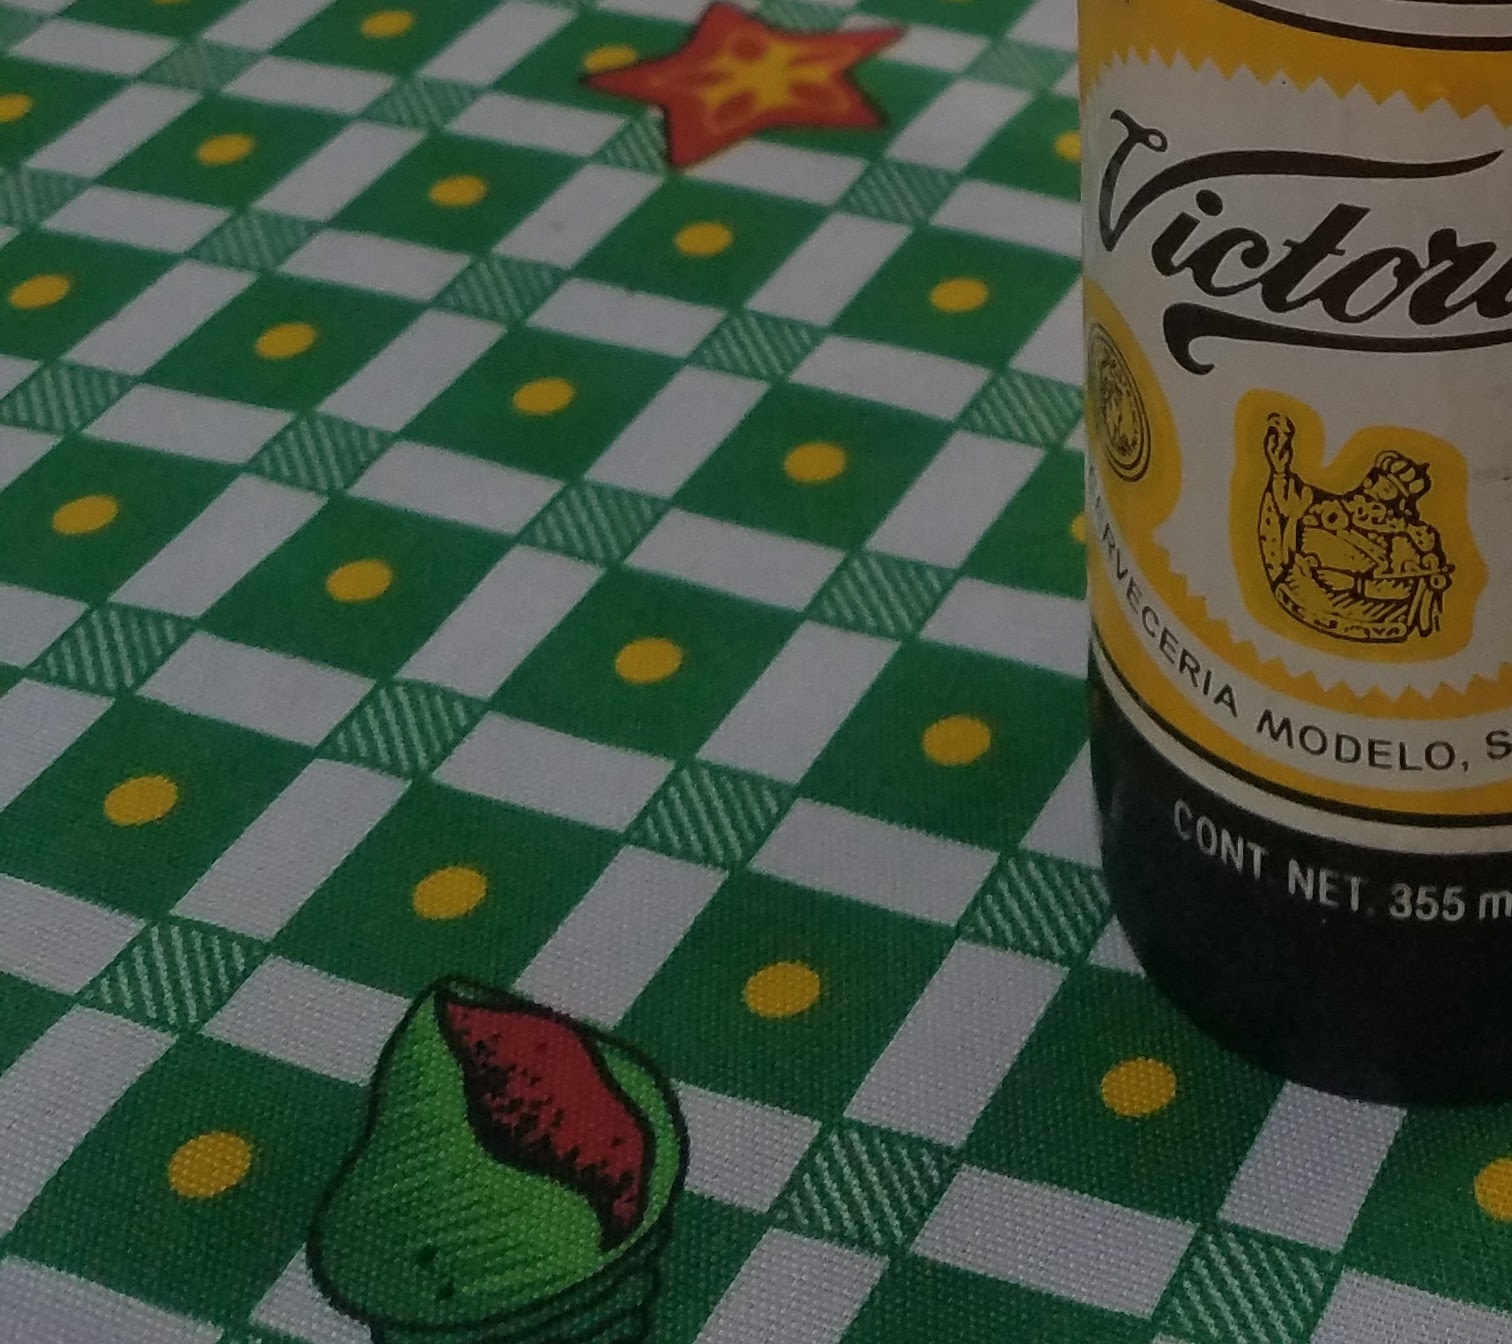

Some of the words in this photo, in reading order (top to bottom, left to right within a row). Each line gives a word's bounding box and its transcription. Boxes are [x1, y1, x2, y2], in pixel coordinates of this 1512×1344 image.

[1089, 467, 1239, 718] RVECERIA
[1256, 708, 1470, 772] MODELO,
[1173, 798, 1267, 880] CONT
[1388, 882, 1466, 922] 355
